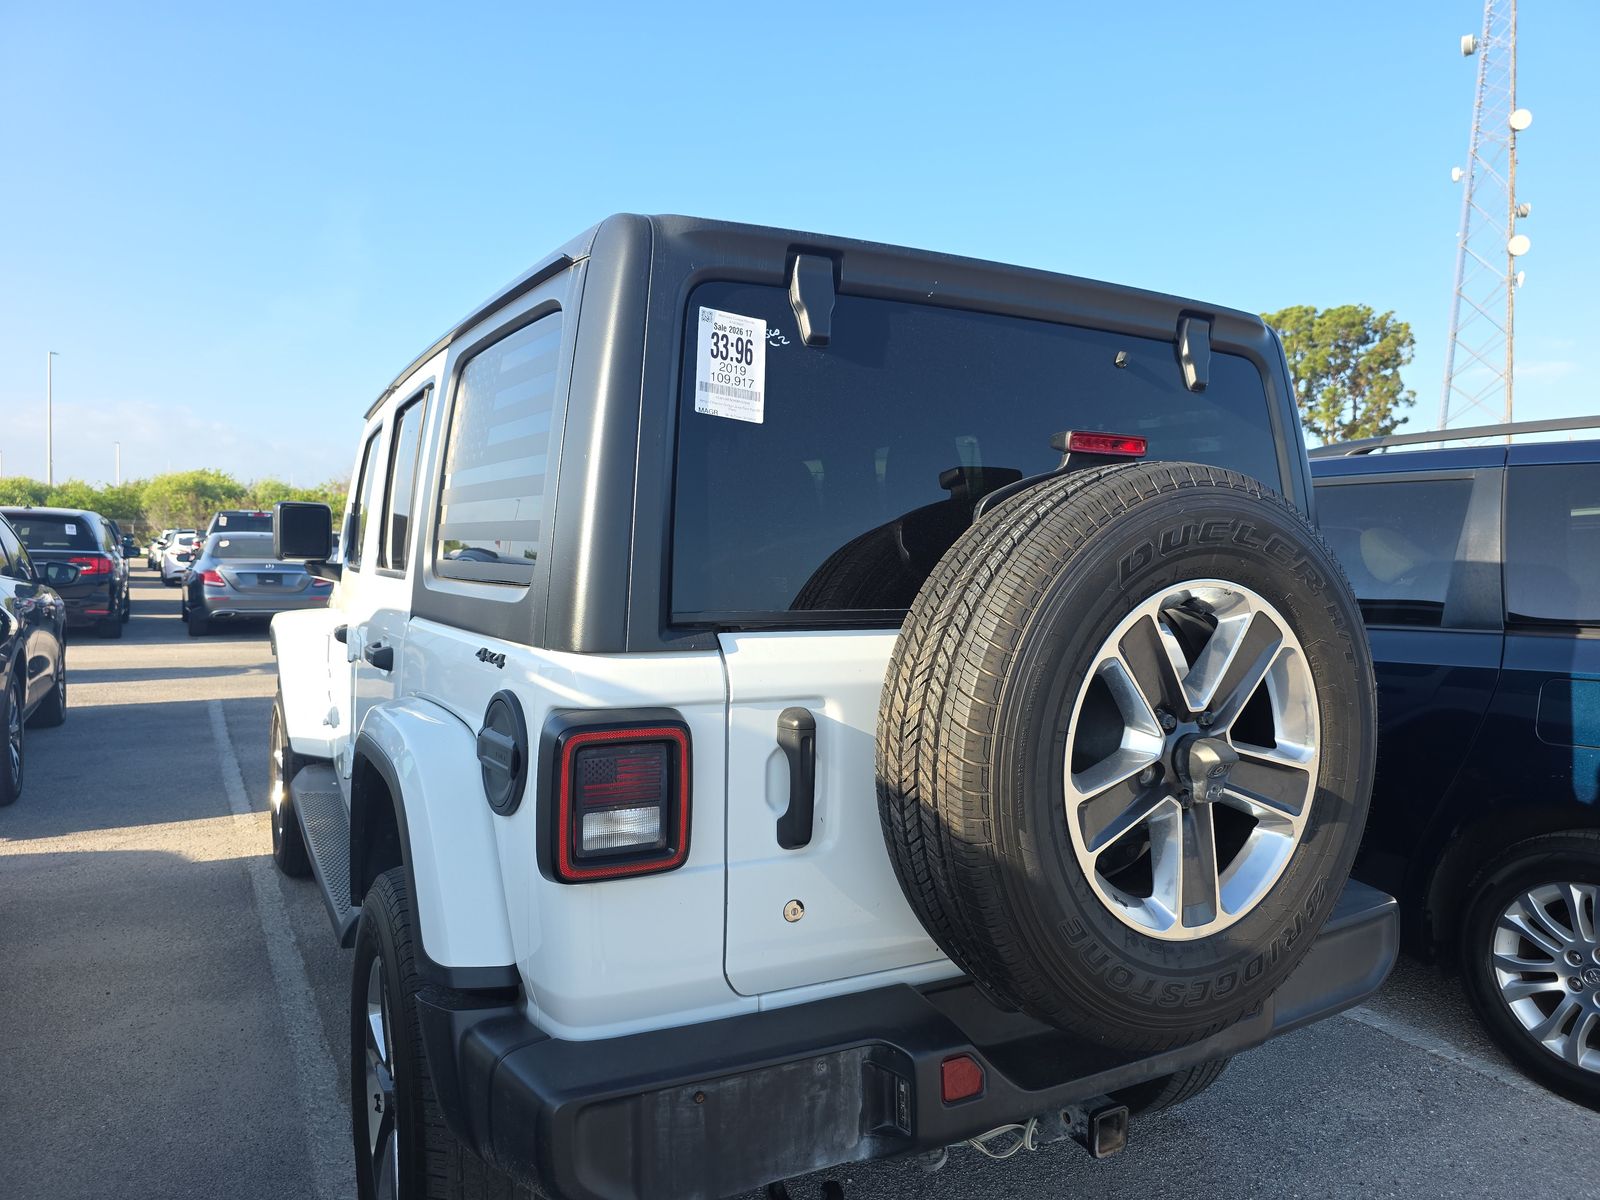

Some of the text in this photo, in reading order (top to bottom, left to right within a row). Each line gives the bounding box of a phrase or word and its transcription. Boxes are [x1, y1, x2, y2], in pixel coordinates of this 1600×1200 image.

[713, 322, 753, 337] Sale 2026 17
[710, 331, 753, 366] 33:96
[719, 361, 747, 376] 2019
[711, 372, 755, 388] 109,917
[1117, 517, 1328, 598] DUELER
[475, 647, 506, 669] 4x4
[1057, 874, 1329, 1008] BRIDGESTONE
